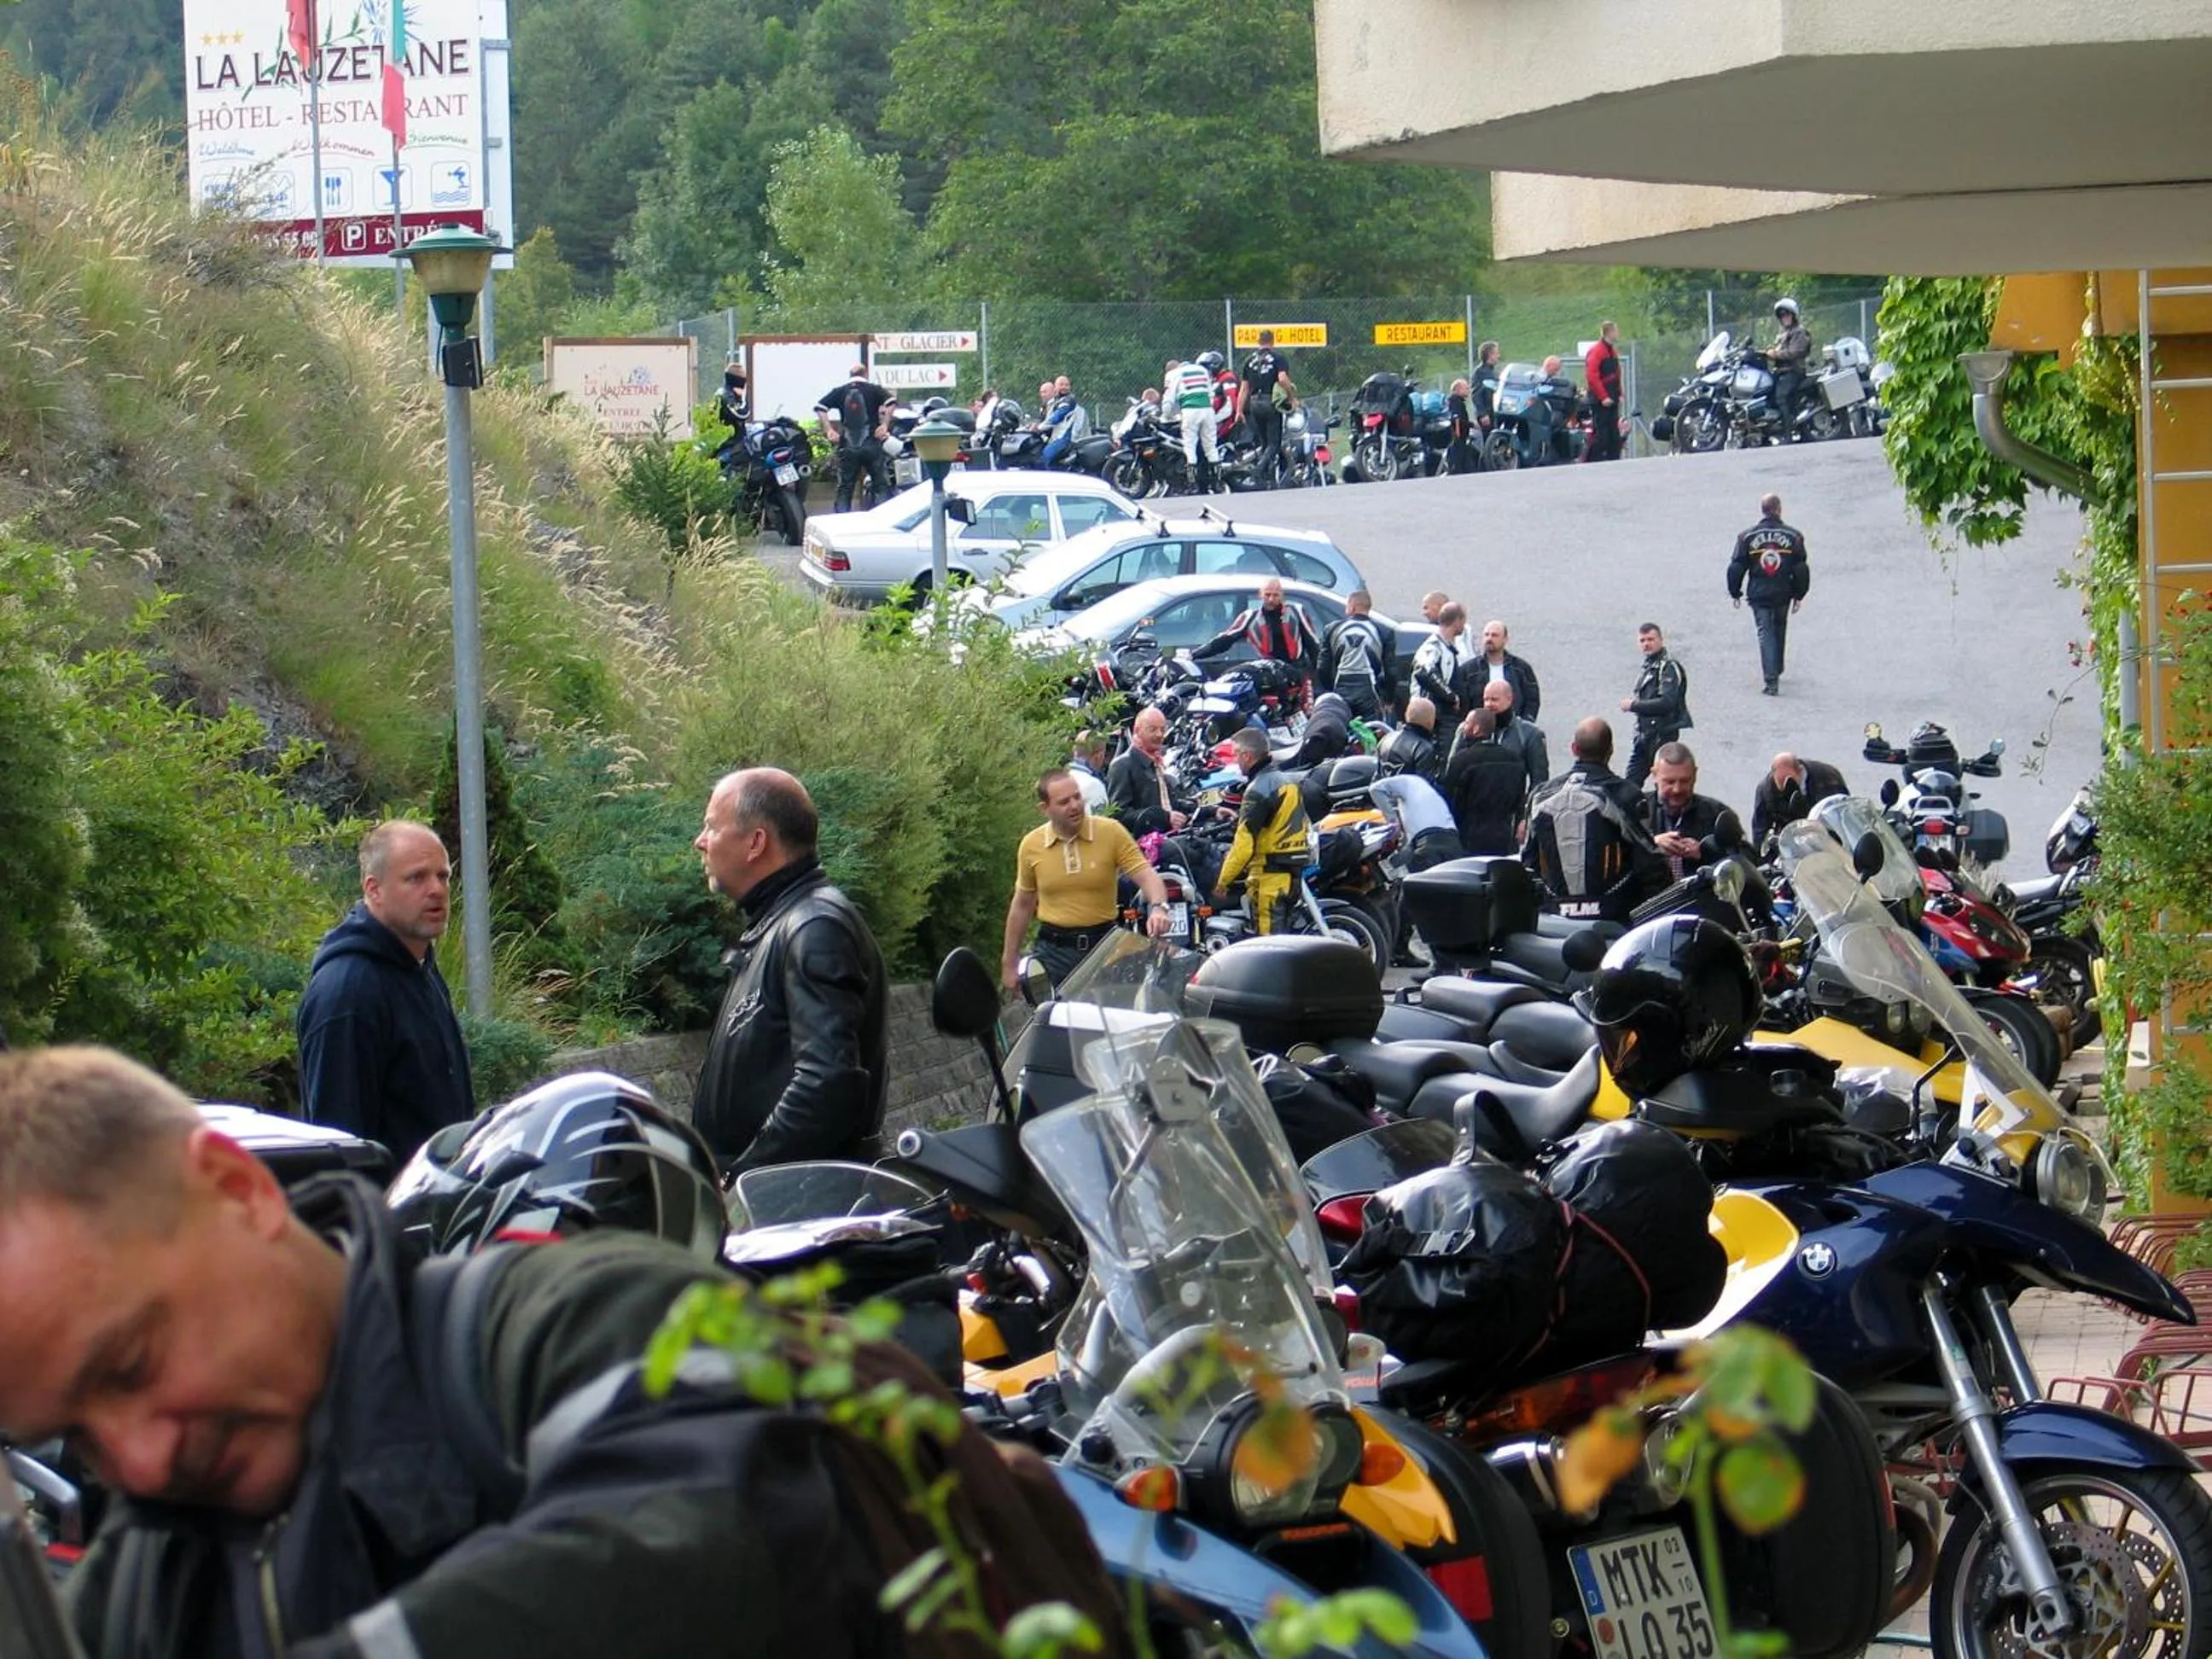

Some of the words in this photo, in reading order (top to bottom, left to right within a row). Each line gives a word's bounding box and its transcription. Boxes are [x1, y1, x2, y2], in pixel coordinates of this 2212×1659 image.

[195, 55, 241, 90] LA
[198, 101, 280, 131] HÔTEL
[300, 94, 468, 125] RESTARANT
[900, 334, 958, 350] GLACIER
[1237, 329, 1284, 343] PARG
[1289, 327, 1322, 343] HOTEL
[1386, 325, 1452, 341] RESTAURANT
[884, 370, 905, 384] DU
[907, 368, 935, 383] LAC
[1599, 1540, 1674, 1610] MTK
[1667, 1600, 1714, 1659] 35
